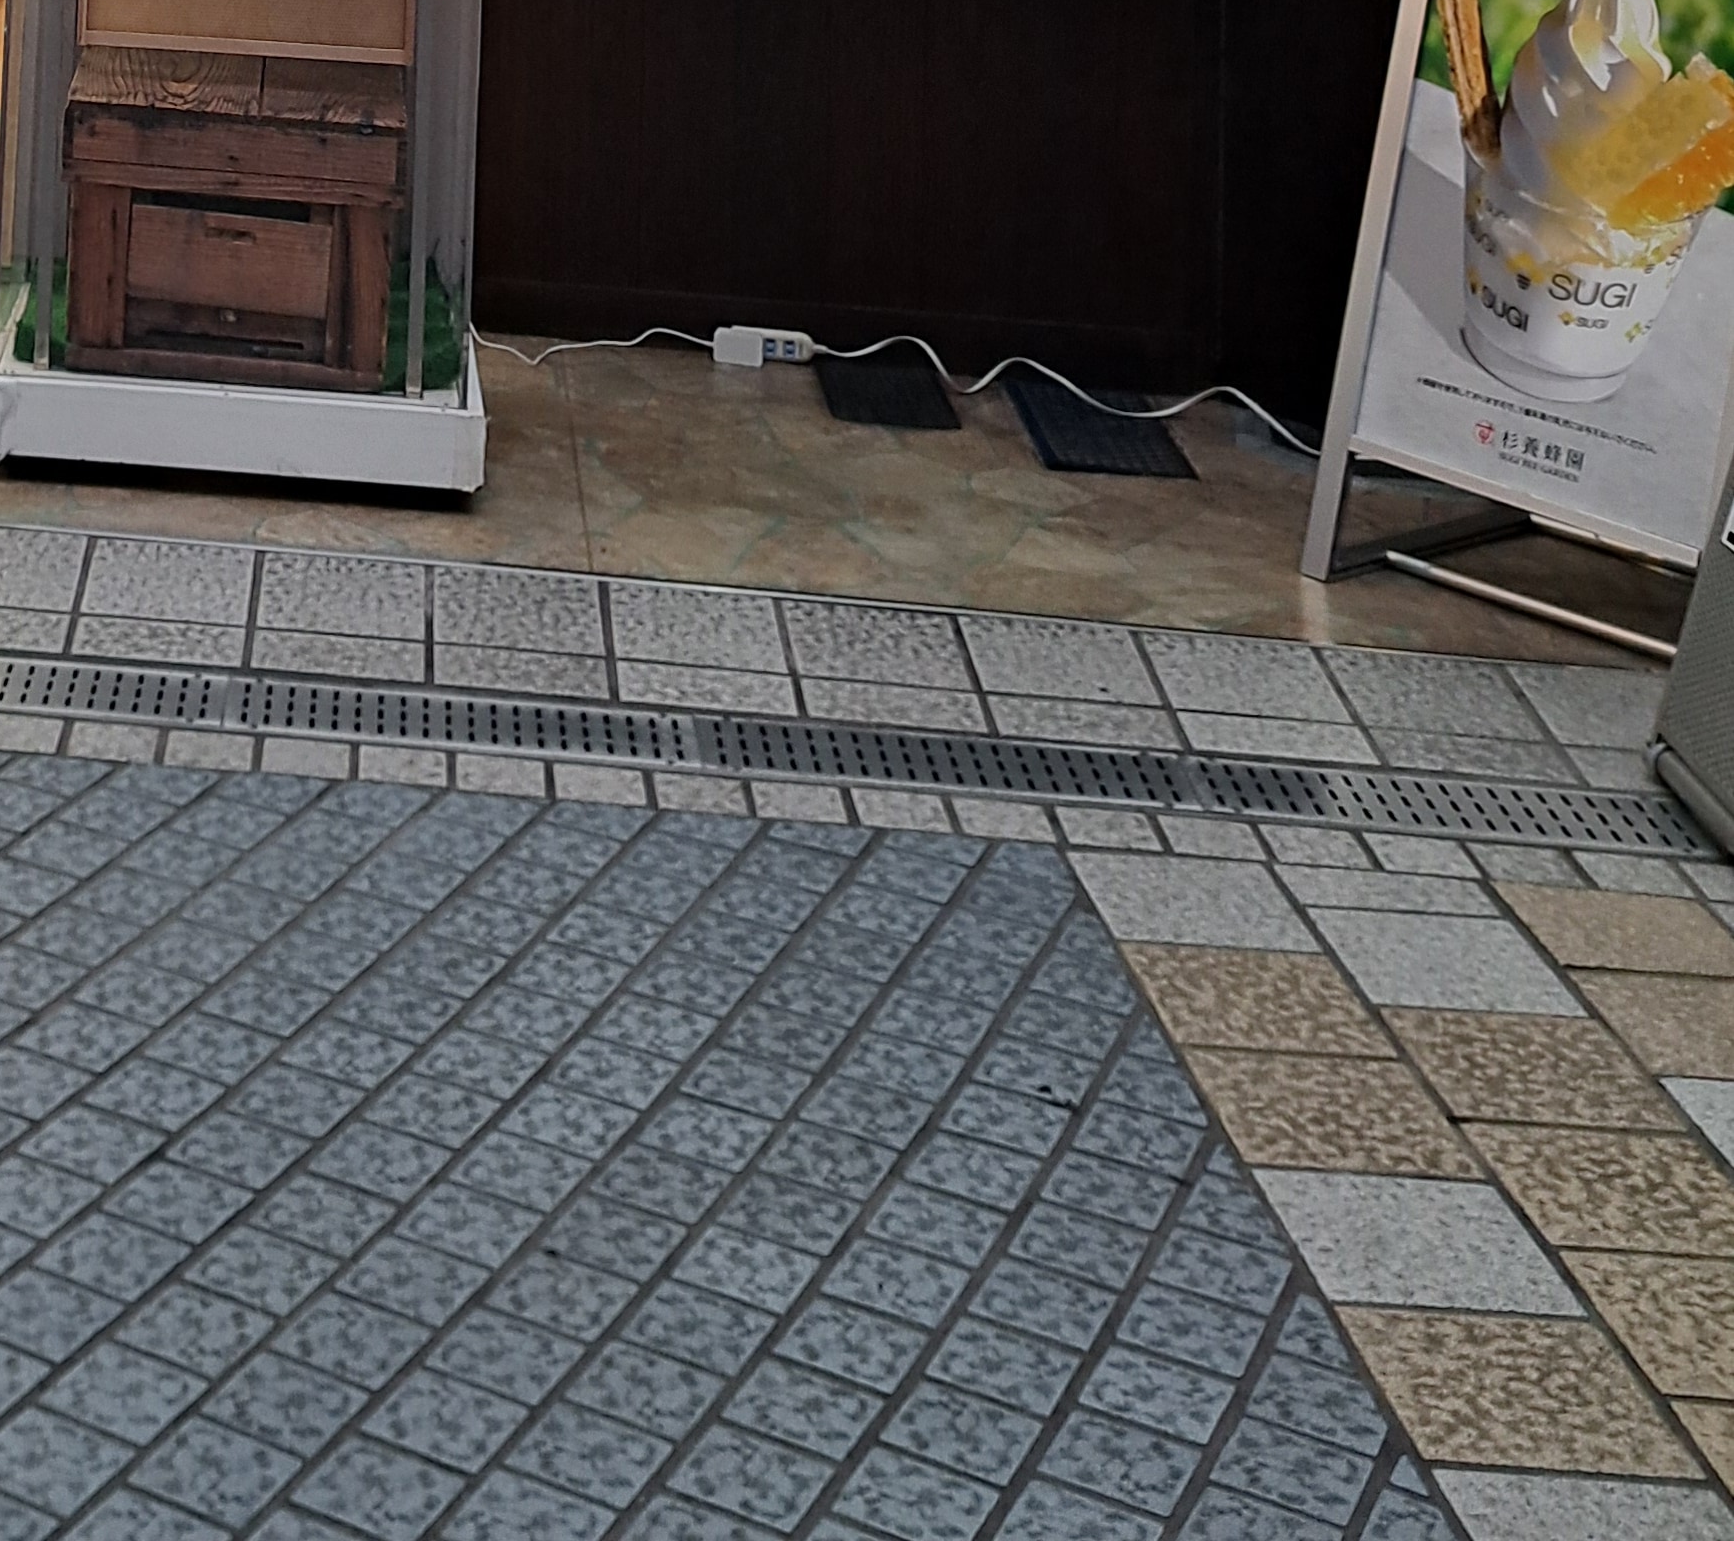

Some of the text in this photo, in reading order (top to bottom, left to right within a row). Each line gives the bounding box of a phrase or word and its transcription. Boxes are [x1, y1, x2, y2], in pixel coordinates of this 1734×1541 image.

[1548, 274, 1638, 309] SUGI
[1574, 316, 1610, 330] SUGI
[1501, 429, 1585, 472] 杉養蜂園
